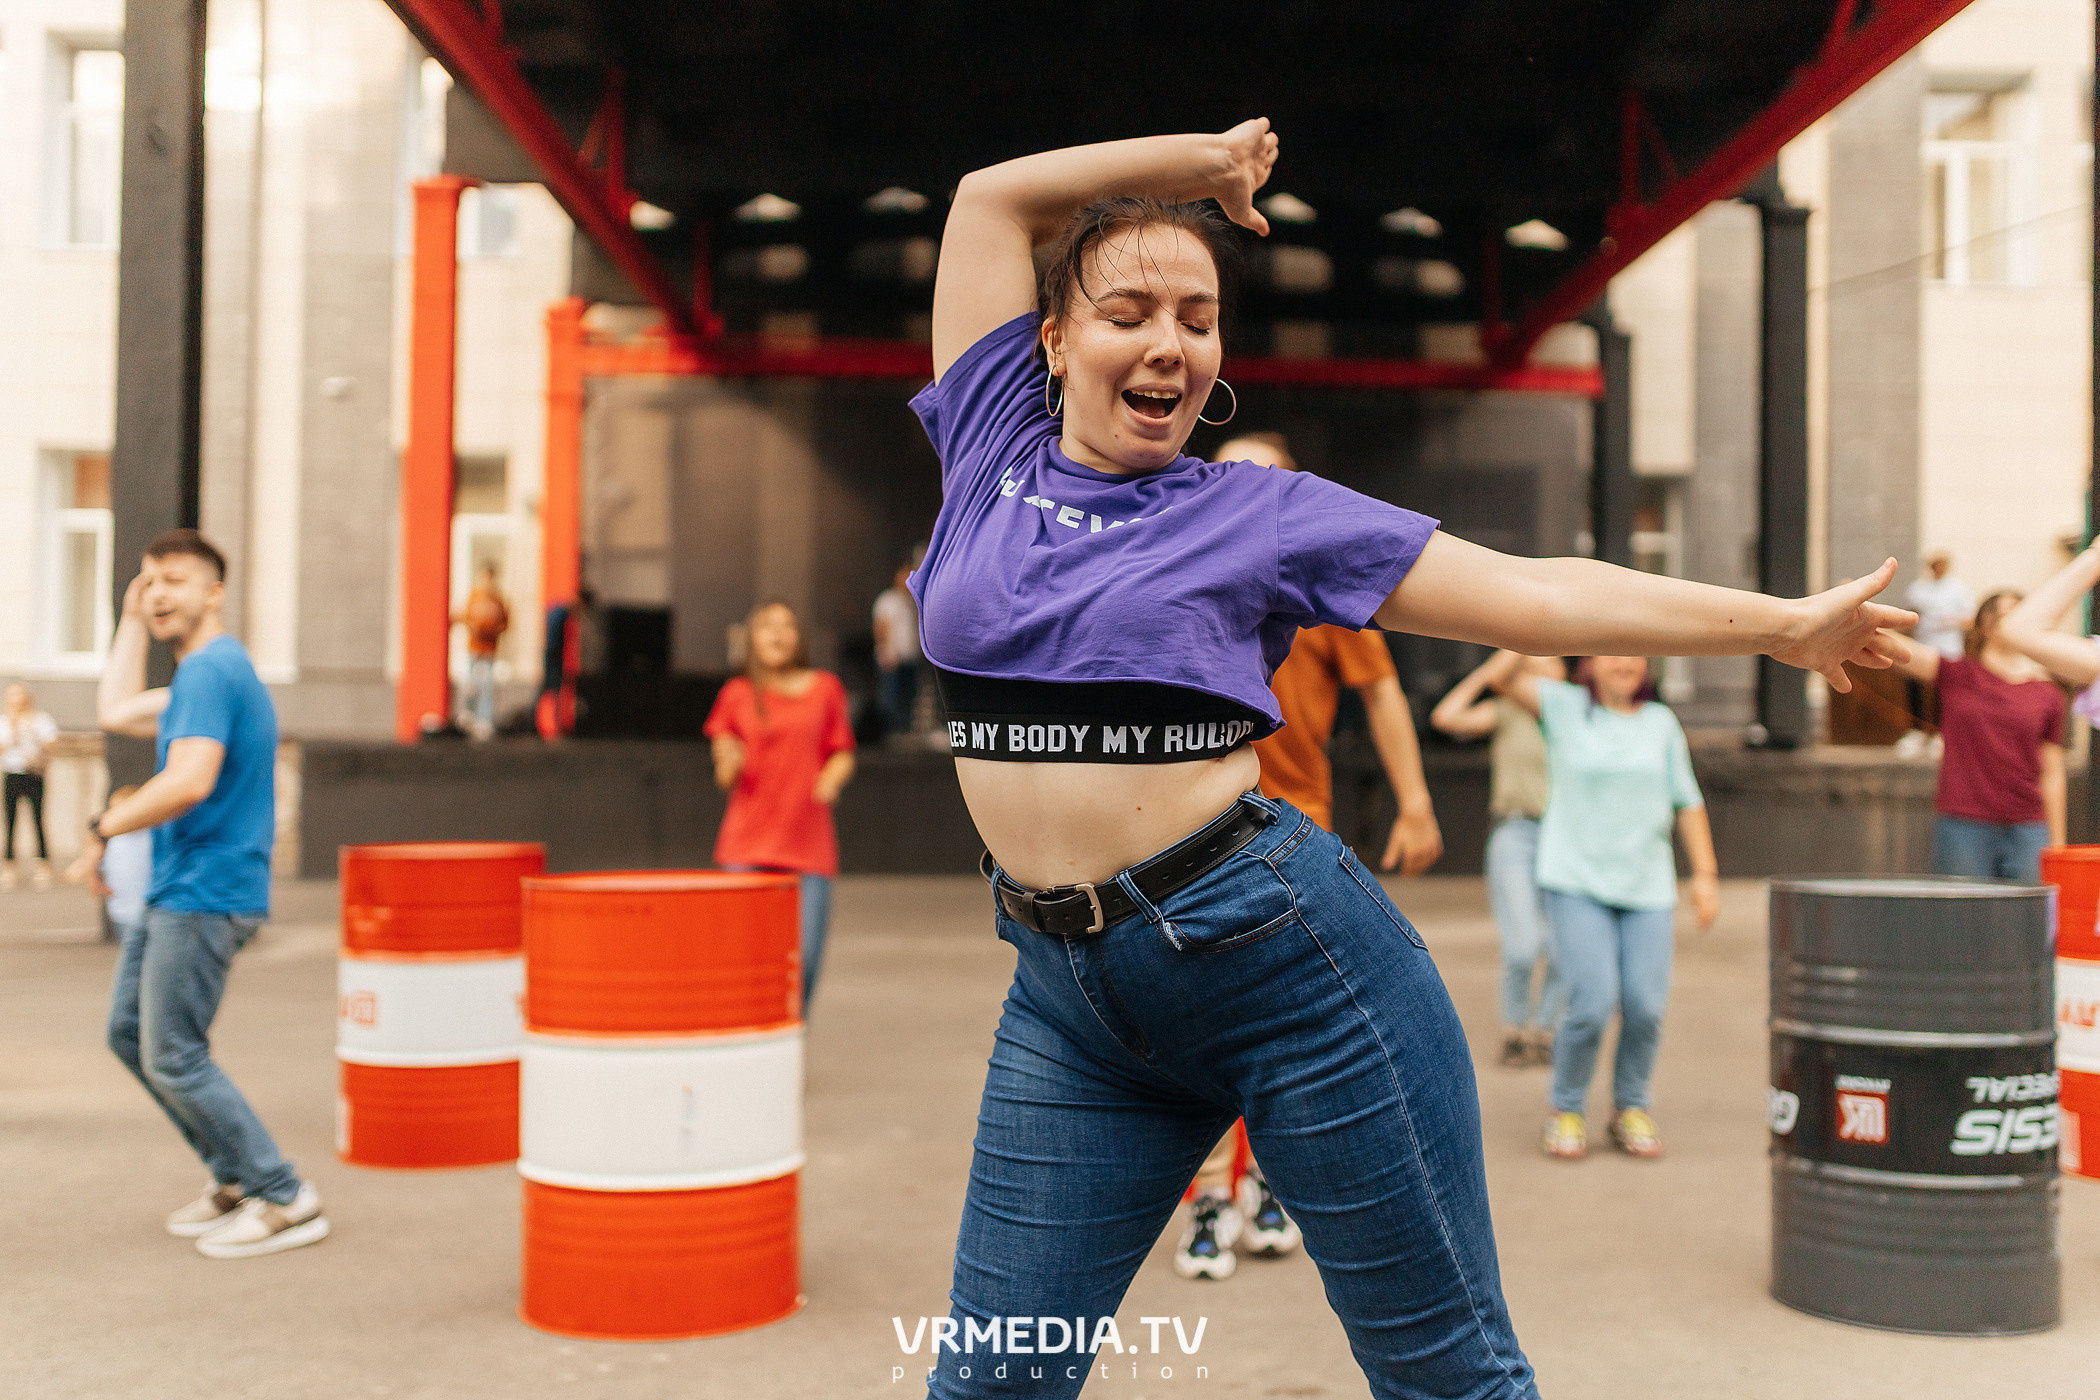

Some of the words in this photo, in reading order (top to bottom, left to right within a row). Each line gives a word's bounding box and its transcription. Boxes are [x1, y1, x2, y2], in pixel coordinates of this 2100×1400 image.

[971, 722, 999, 751] MY
[1008, 724, 1090, 753] BODY
[1102, 725, 1156, 754] MY
